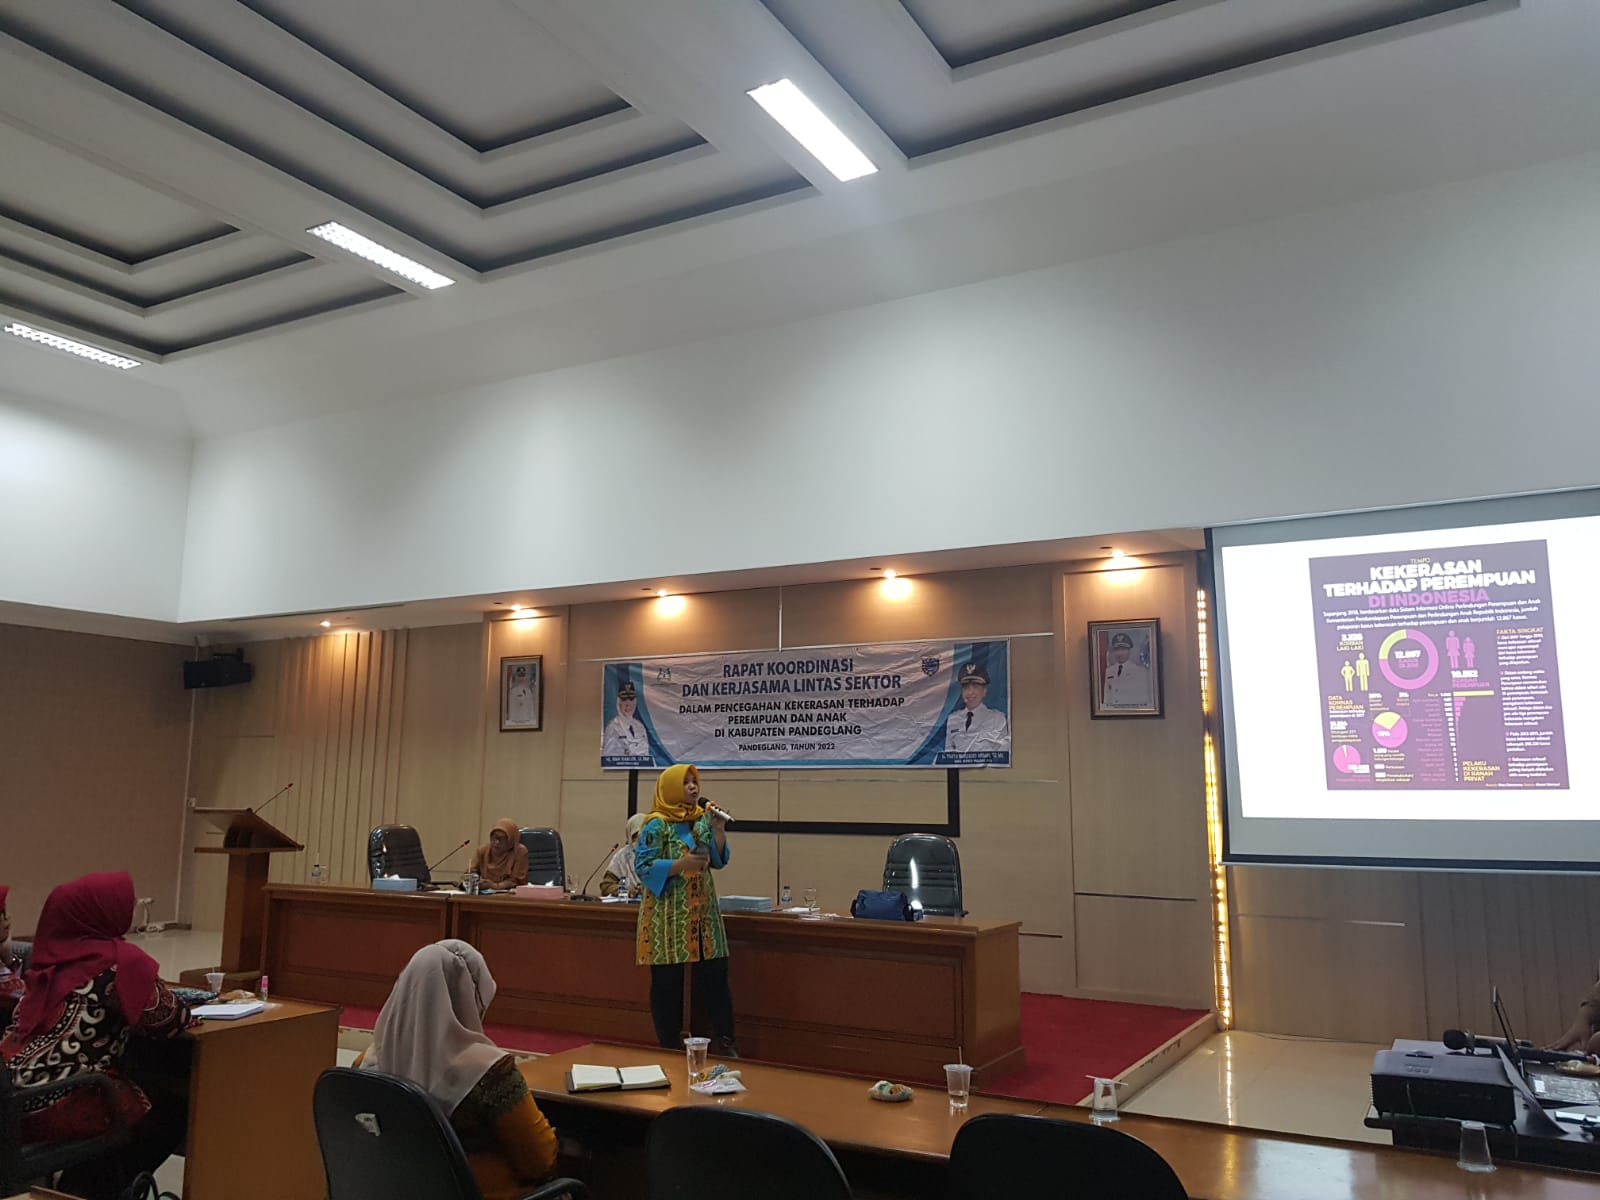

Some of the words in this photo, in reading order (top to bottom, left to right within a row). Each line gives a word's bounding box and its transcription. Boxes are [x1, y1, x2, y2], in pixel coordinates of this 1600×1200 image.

[1370, 559, 1482, 580] KEKERASAN
[1323, 579, 1418, 597] TERHADAP
[1420, 570, 1536, 591] PEREMPUAN
[1368, 594, 1386, 608] DI
[1389, 588, 1490, 607] INDONESIA
[723, 662, 764, 678] RAPAT
[767, 658, 853, 676] KOORDINASI
[682, 684, 709, 697] DAN
[712, 680, 790, 696] KERJASAMA
[794, 677, 842, 693] LINTAS
[845, 675, 901, 691] SEKTOR
[679, 704, 711, 714] DALAM
[714, 702, 781, 713] PENCEGAHAN
[785, 699, 845, 711] KEKERASAN
[848, 697, 905, 708] TERHADAP
[728, 714, 787, 725] PEREMPUAN
[790, 713, 813, 724] DAN
[816, 712, 847, 722] ANAK
[714, 728, 725, 738] DI
[728, 727, 785, 737] KABUPATEN
[788, 725, 862, 737] PANDEGLANG
[738, 743, 788, 752] PANDEGLANG,
[790, 743, 816, 751] TAHUN
[817, 742, 835, 751] 2022
